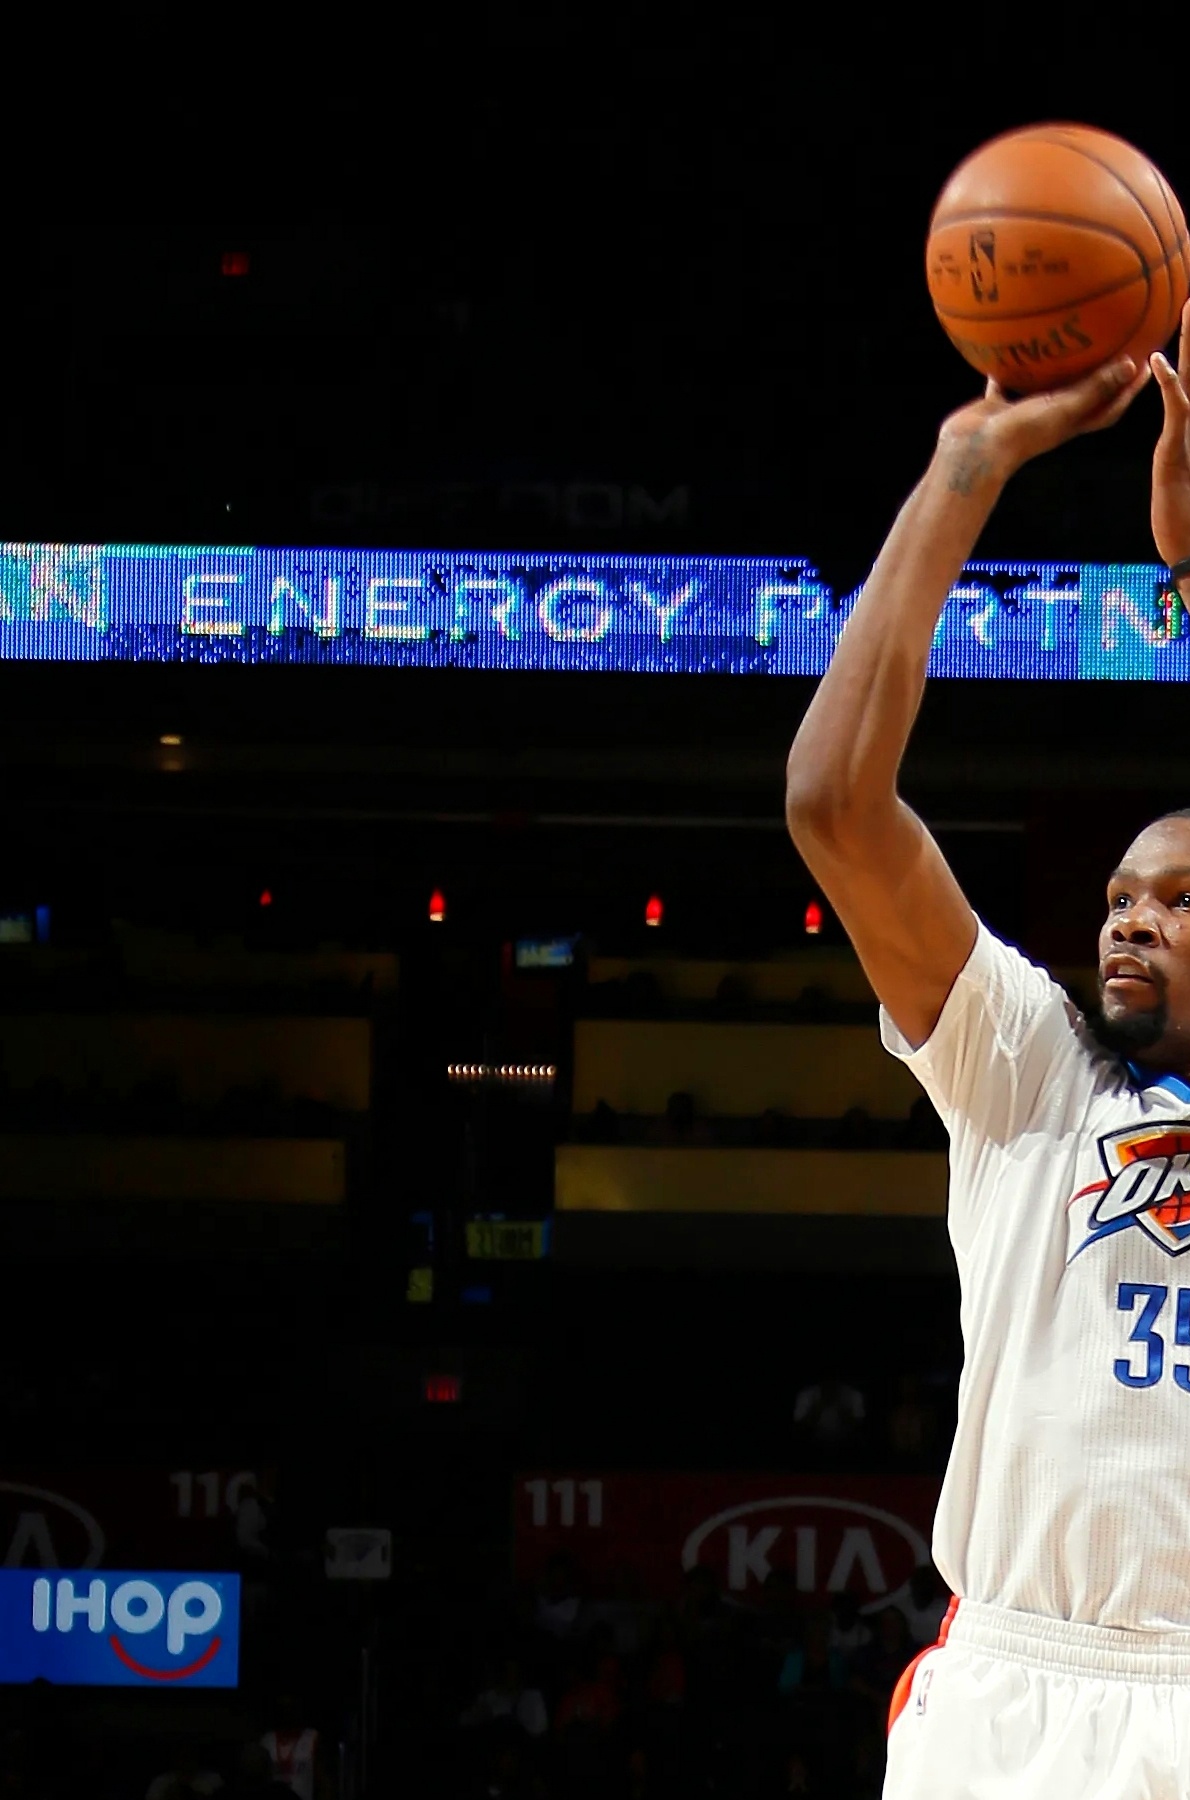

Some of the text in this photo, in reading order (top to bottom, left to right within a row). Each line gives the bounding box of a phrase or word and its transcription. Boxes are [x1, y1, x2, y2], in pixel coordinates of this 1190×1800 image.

[181, 573, 703, 642] ENERGY
[524, 1478, 603, 1528] 111
[726, 1524, 888, 1593] KIA
